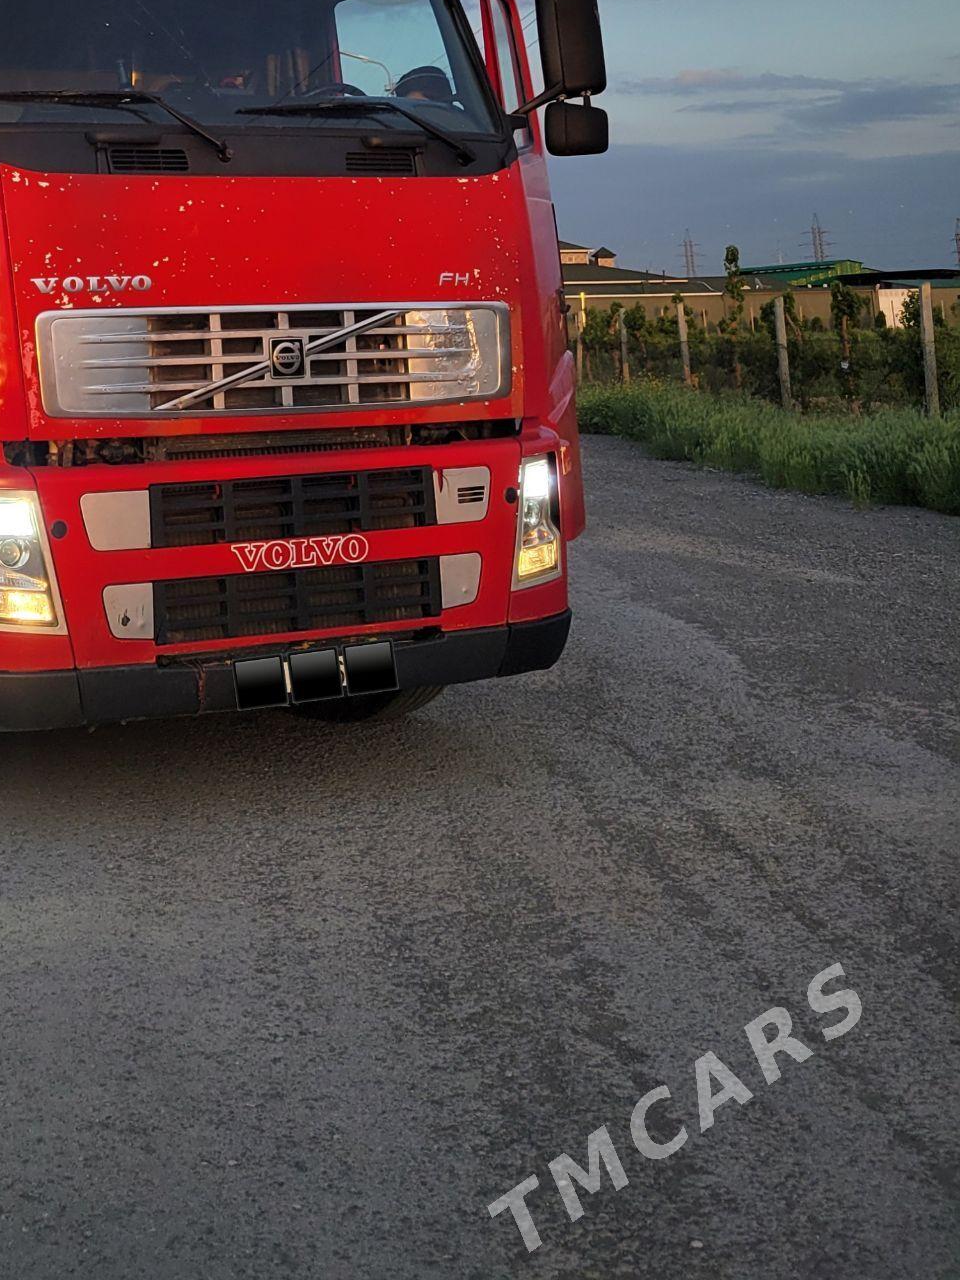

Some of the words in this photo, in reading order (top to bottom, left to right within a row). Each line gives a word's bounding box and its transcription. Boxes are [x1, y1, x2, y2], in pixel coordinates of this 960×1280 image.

[30, 275, 152, 293] VOLVO
[439, 272, 470, 286] FH
[231, 534, 369, 572] VOLVO
